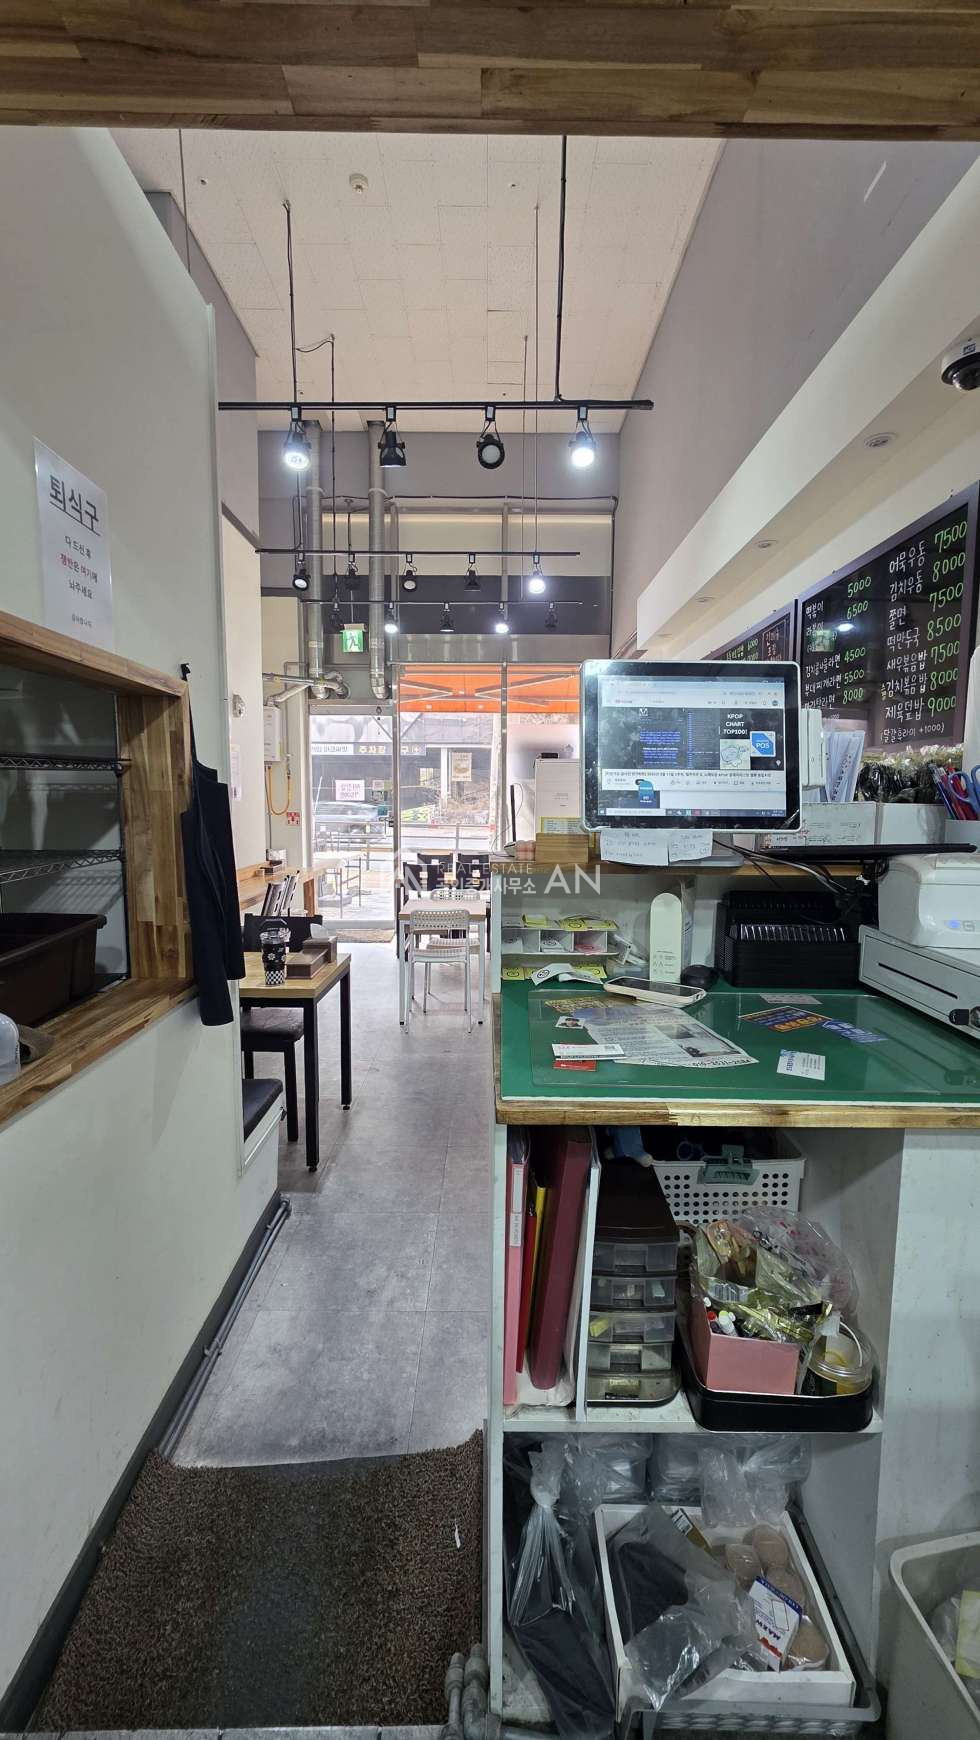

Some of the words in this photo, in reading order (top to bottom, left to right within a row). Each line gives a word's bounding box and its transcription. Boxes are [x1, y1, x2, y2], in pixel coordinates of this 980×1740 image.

[49, 474, 100, 532] 퇴식구
[889, 539, 927, 575] 어묵우동
[934, 520, 968, 553] 7500
[847, 576, 872, 598] 5000
[889, 570, 924, 602] 김치우동
[932, 551, 967, 583] 8000
[805, 600, 824, 620] 떡볶이
[846, 600, 869, 620] 6500
[888, 605, 908, 631] 쫄면
[928, 582, 964, 614] 7500
[887, 627, 921, 654] 떡만두국
[927, 613, 962, 642] 8500
[844, 647, 866, 664] 4500
[886, 650, 928, 675] 새우볶음밥
[931, 640, 961, 668] 7500
[843, 669, 865, 685] 5500
[929, 667, 960, 693] 8000
[842, 687, 864, 705] 8000
[884, 697, 925, 723] 제육덮밥
[927, 695, 957, 718] 9000
[755, 741, 770, 750] POS
